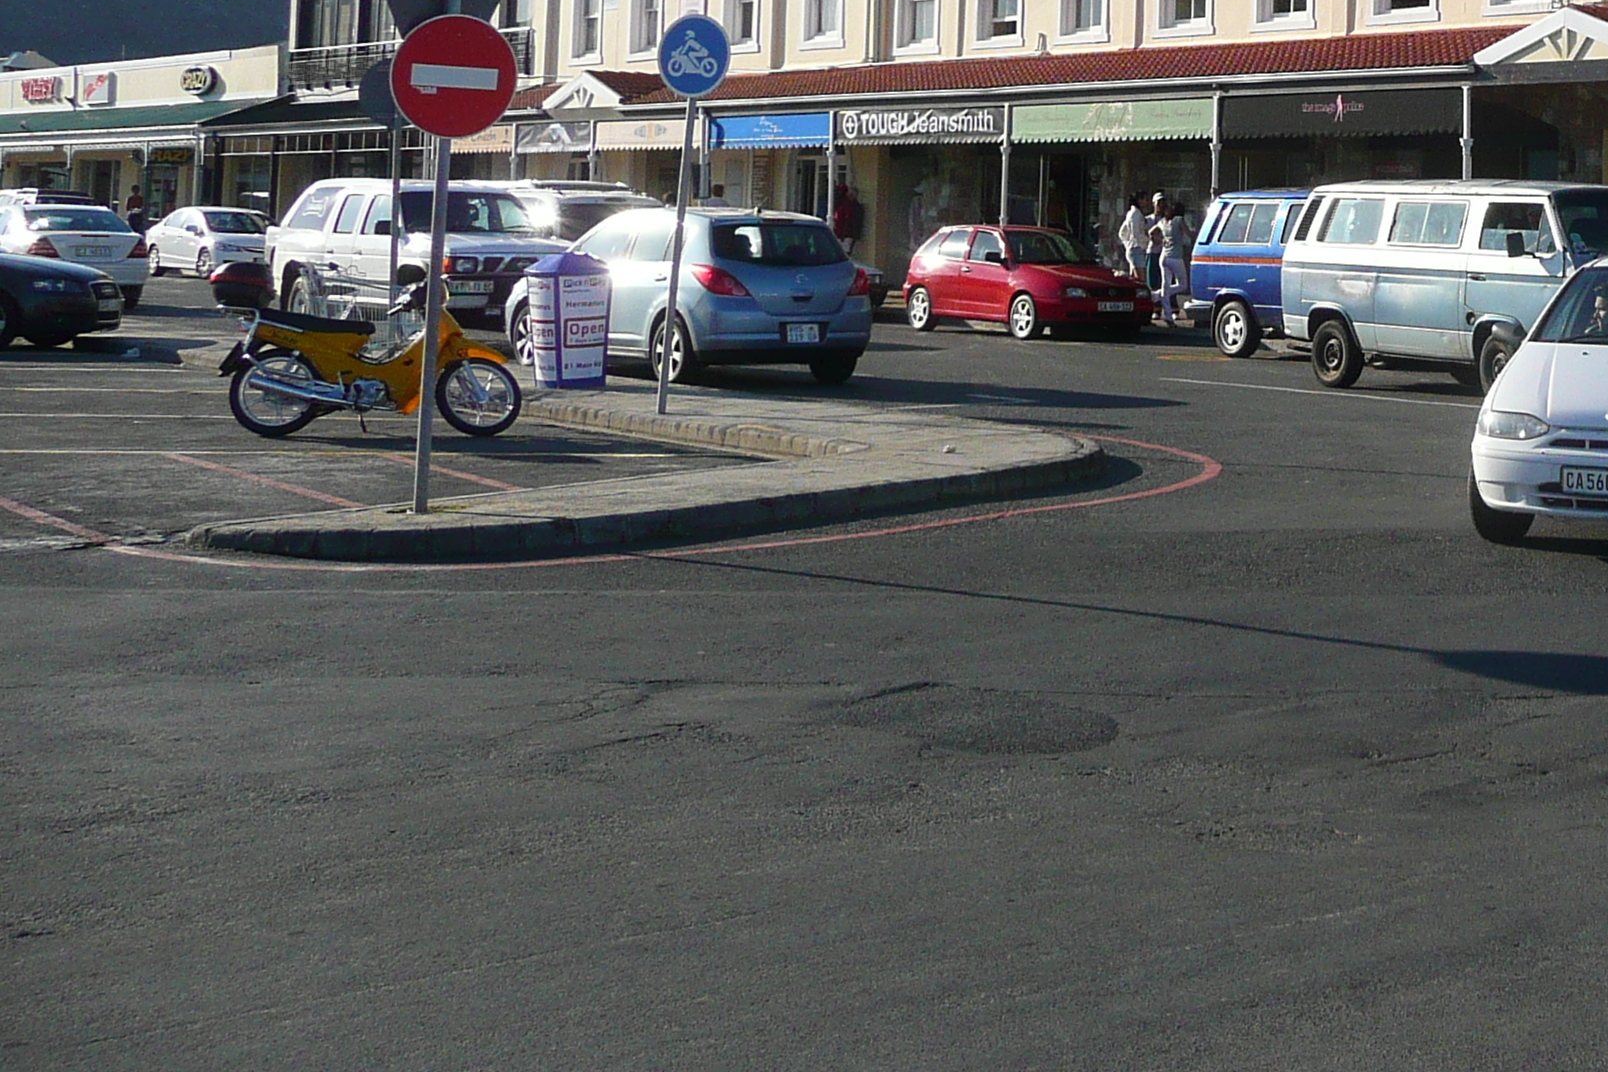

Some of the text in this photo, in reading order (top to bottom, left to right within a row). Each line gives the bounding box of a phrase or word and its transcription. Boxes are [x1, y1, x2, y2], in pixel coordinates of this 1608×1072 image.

[860, 111, 908, 135] TOUGH
[909, 110, 994, 134] Jeansmith
[570, 323, 605, 337] Open
